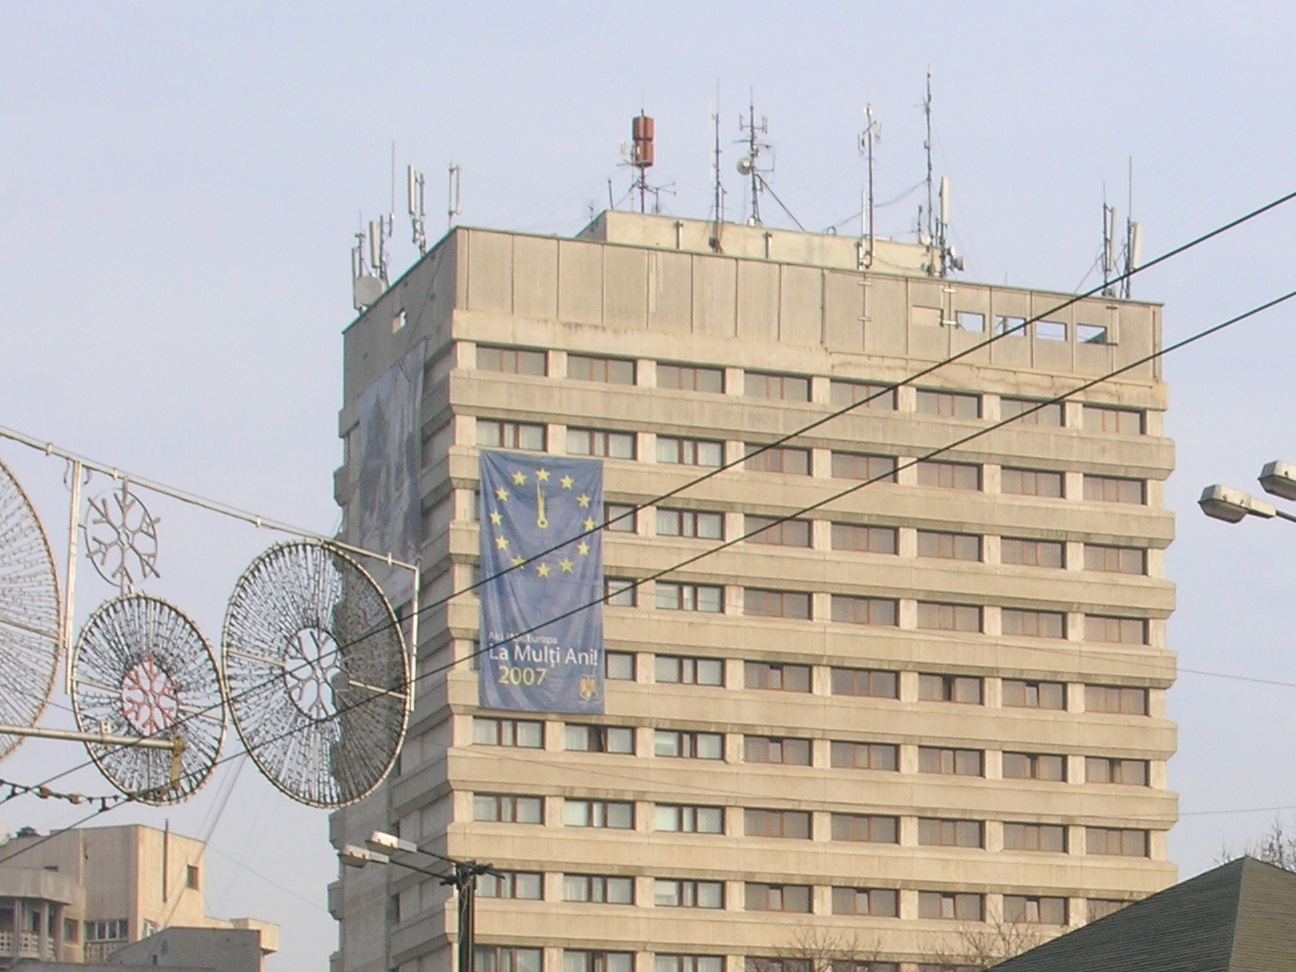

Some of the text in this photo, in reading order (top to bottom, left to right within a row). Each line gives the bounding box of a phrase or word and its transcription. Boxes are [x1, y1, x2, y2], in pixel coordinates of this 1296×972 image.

[489, 644, 509, 660] La
[564, 647, 598, 666] Ani!
[498, 664, 547, 685] 2007
